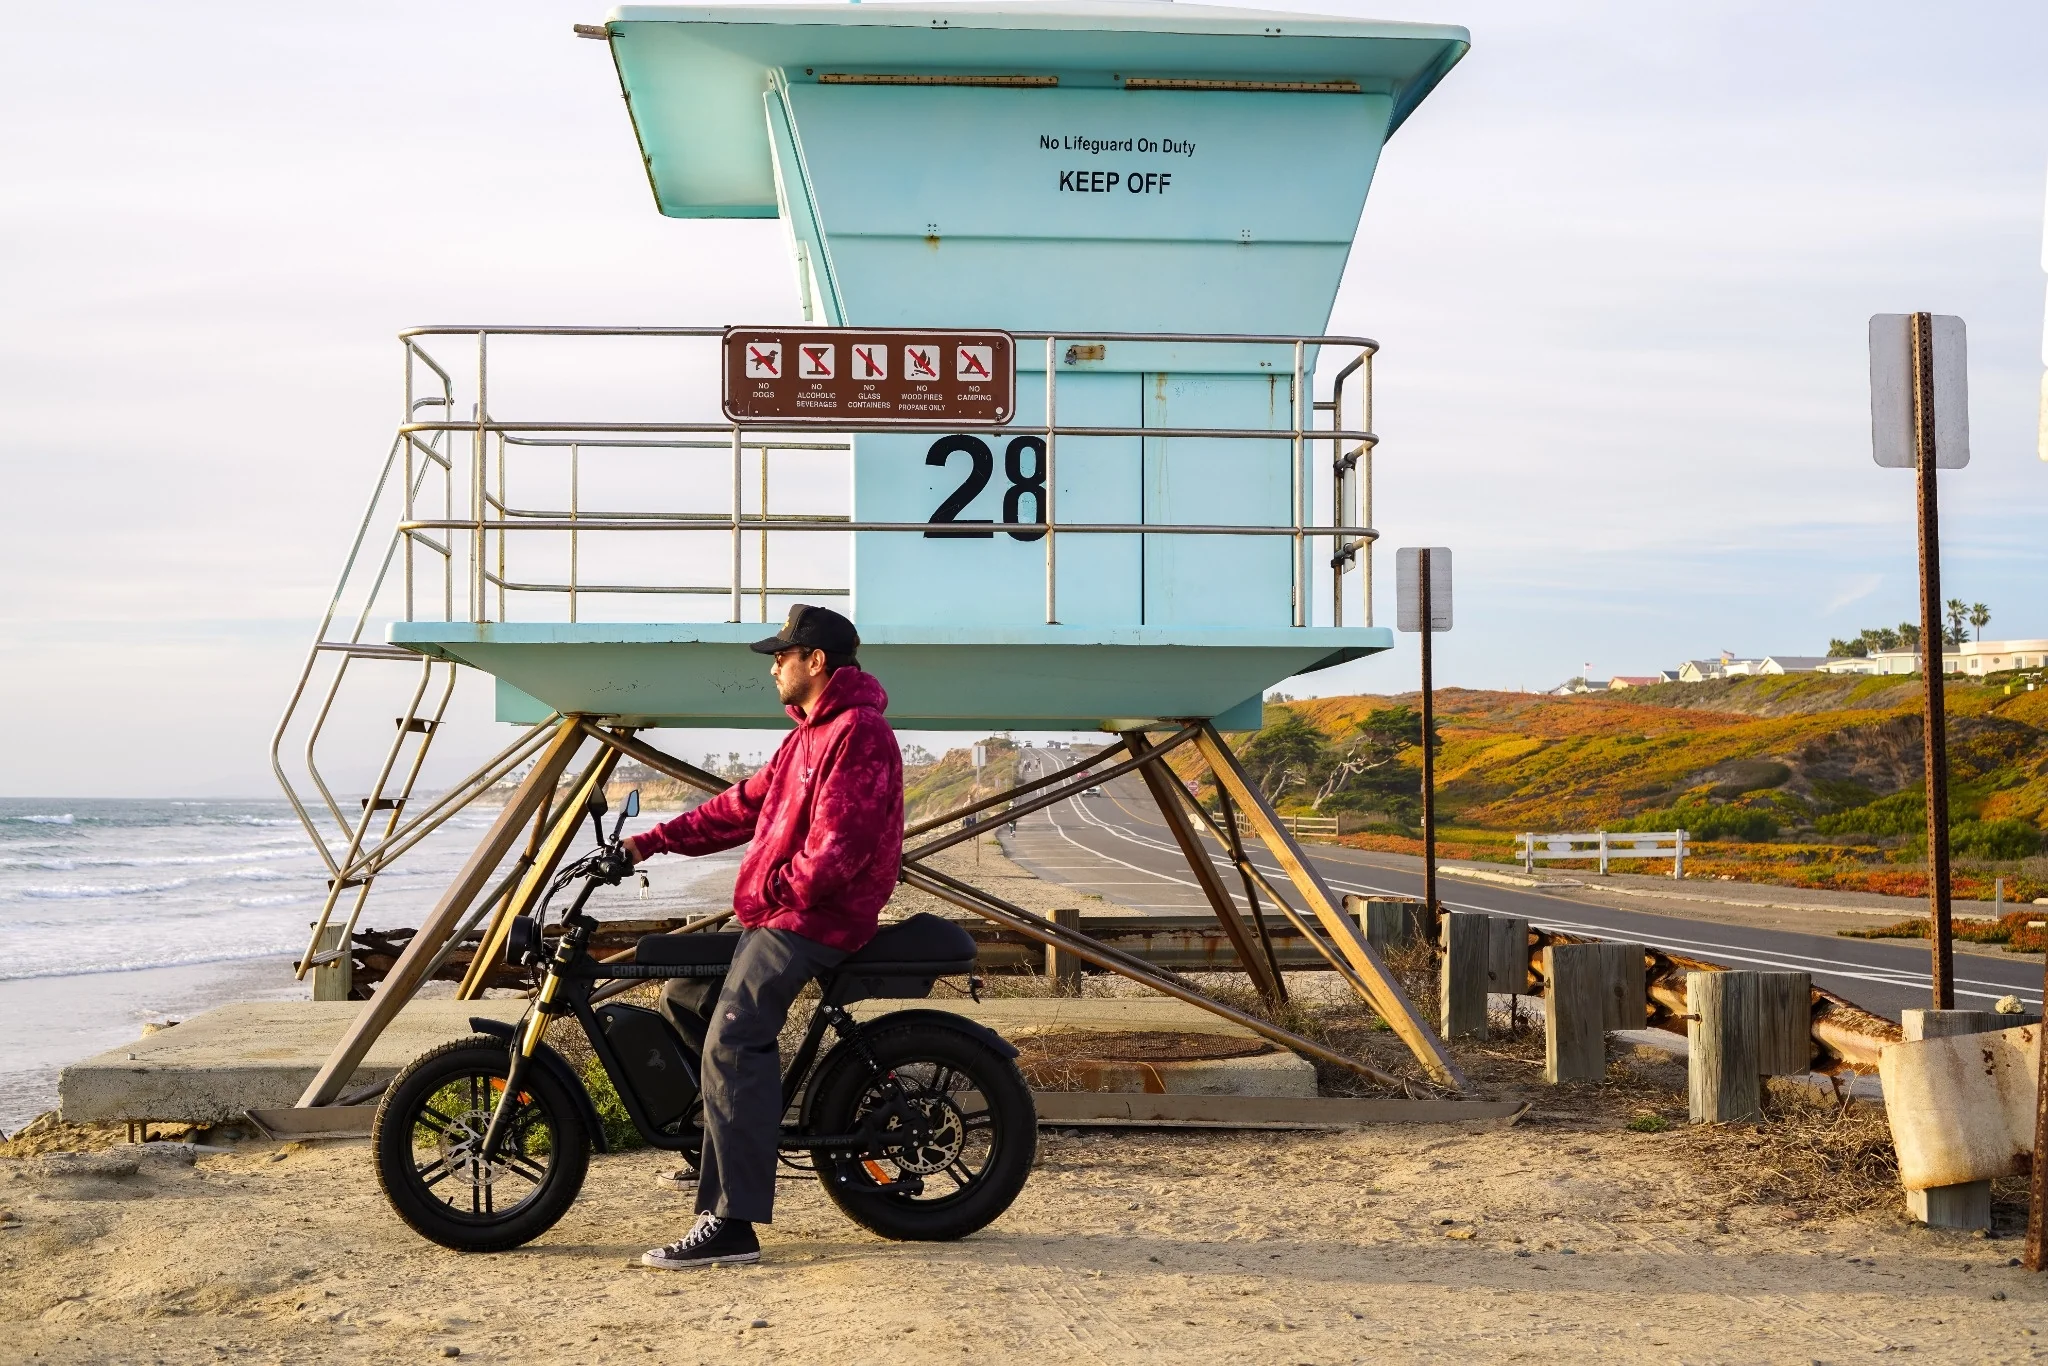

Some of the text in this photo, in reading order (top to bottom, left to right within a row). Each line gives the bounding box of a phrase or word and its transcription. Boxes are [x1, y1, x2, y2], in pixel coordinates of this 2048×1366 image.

[1040, 134, 1196, 157] No Lifeguard On Duty
[1059, 170, 1172, 194] KEEP OFF
[796, 400, 837, 408] BEVERAGES
[847, 401, 891, 409] CONTAINERS
[898, 403, 928, 411] PROPANE
[923, 433, 1049, 542] 28
[611, 965, 645, 977] GOAT
[648, 965, 692, 977] POWER
